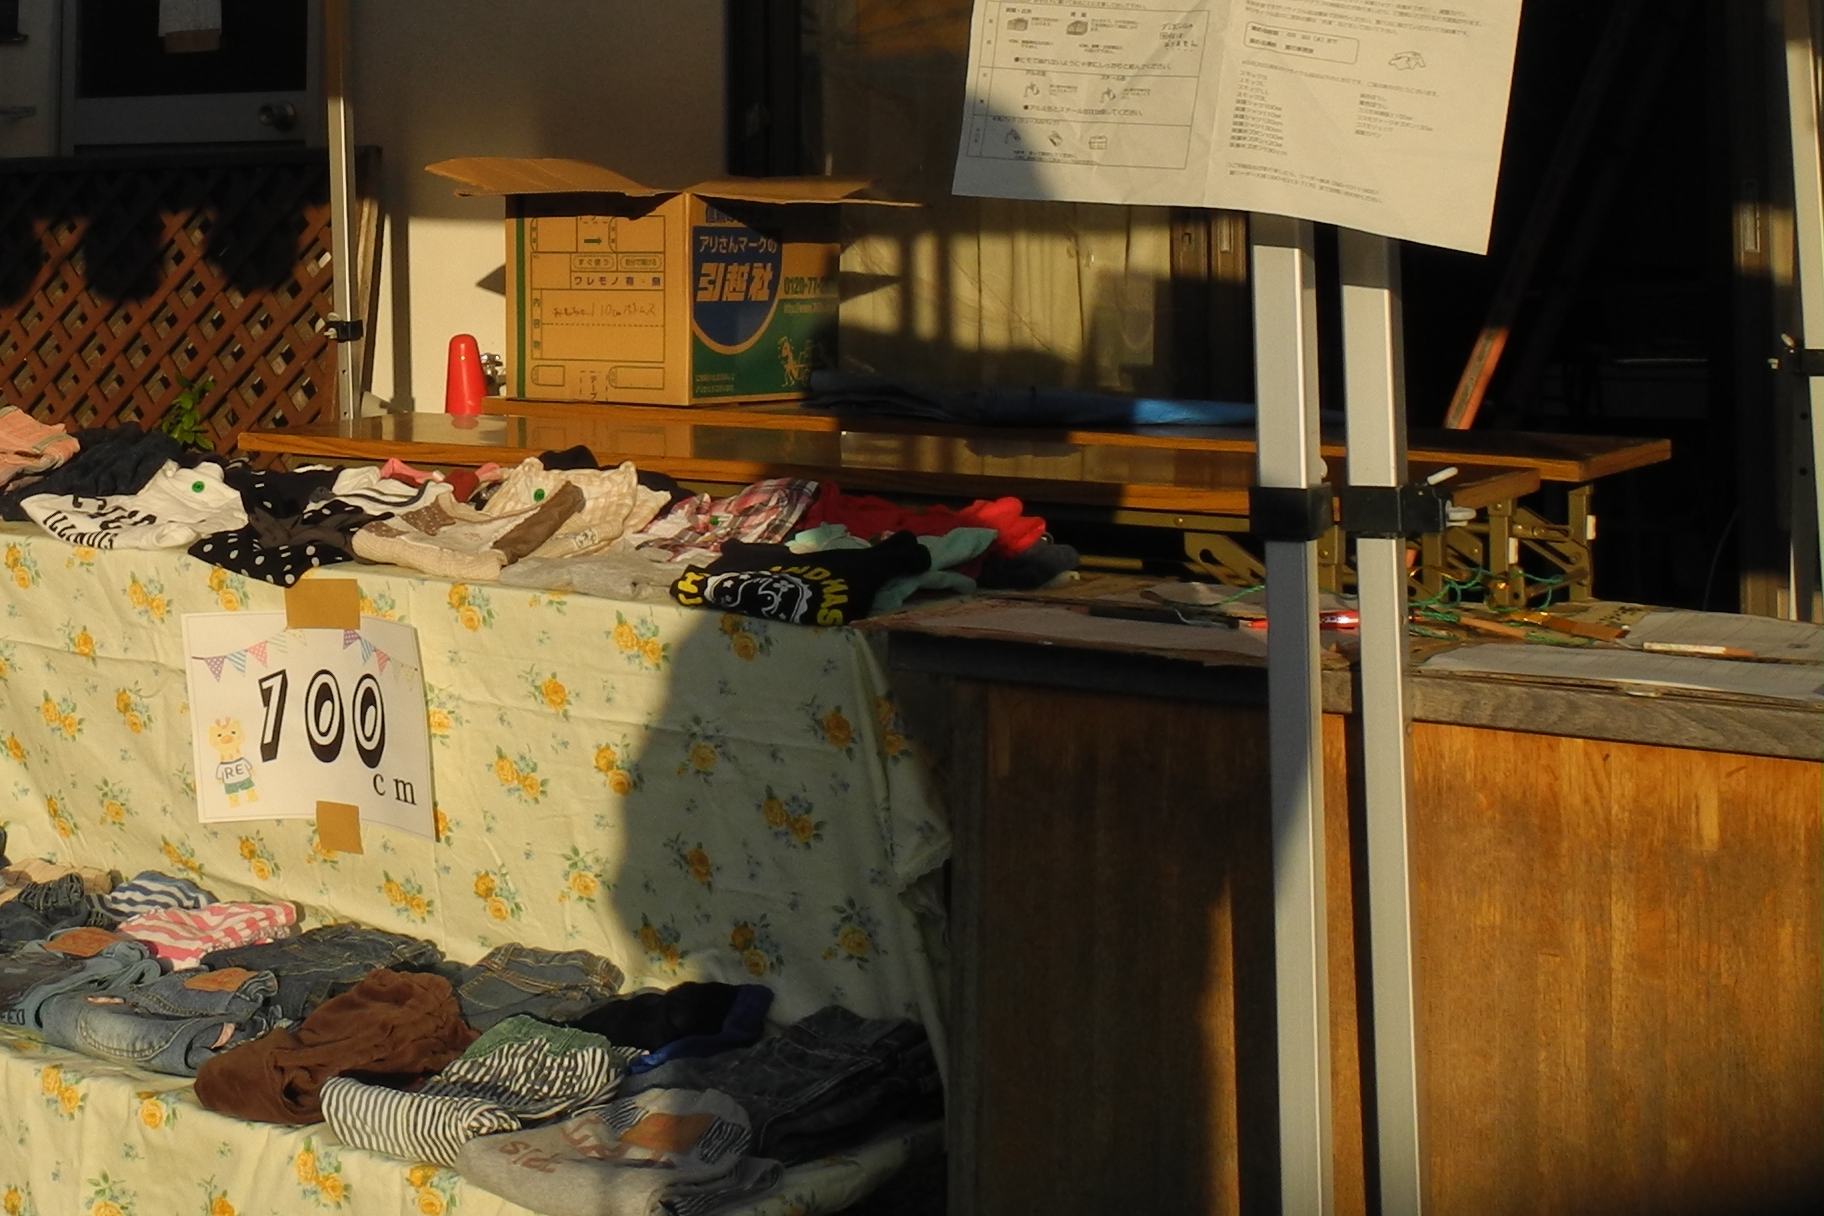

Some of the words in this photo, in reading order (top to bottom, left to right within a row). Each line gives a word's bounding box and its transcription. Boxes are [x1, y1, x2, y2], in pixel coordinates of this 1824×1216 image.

[699, 235, 777, 254] アリさんマークの
[696, 262, 773, 302] 引越社
[258, 668, 386, 769] 100
[224, 764, 245, 780] RE
[373, 772, 418, 806] cm
